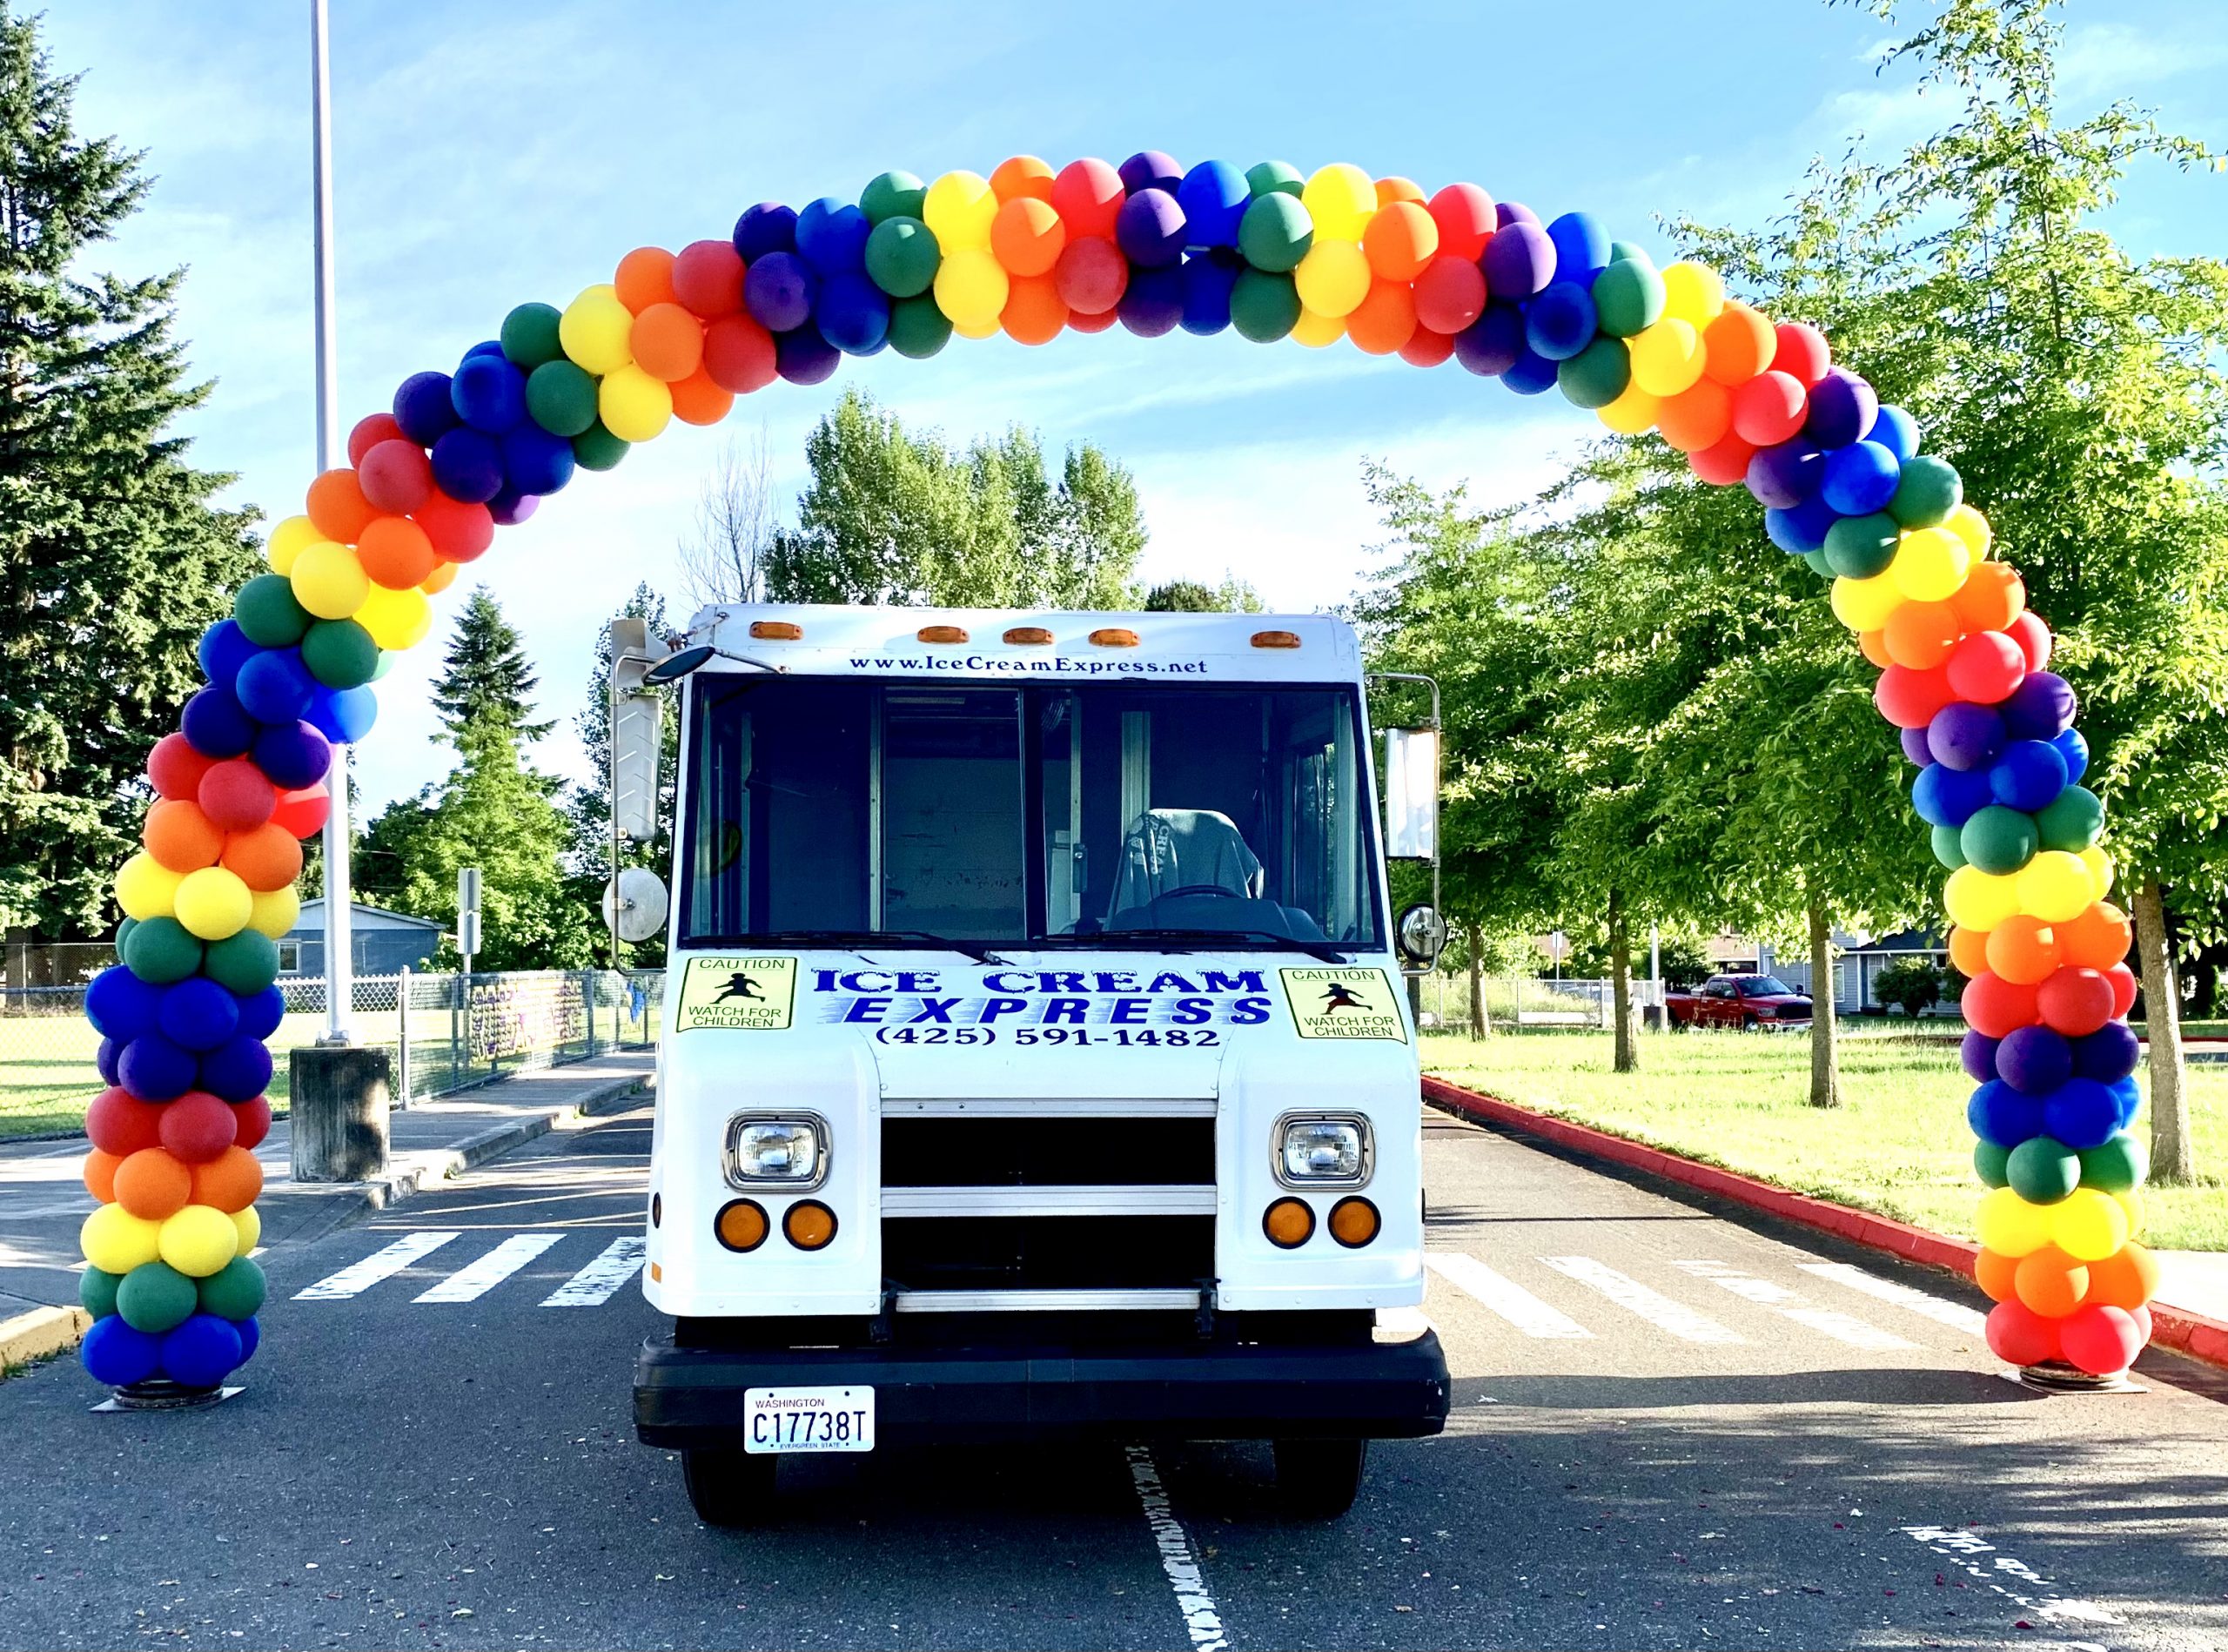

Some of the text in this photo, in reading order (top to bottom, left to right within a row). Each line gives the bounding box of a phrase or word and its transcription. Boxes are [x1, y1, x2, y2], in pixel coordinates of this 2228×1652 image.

[849, 655, 1209, 674] www.IceCreamExpress.net
[699, 959, 785, 970] CAUTION
[811, 967, 1269, 993] ICE CREAM
[1292, 970, 1375, 981] CAUTION
[688, 1006, 782, 1018] WATCH FOR
[842, 997, 1272, 1024] EXPRESS
[693, 1016, 775, 1027] CHILDREN
[1304, 1016, 1395, 1027] WATCH FOR
[876, 1027, 1220, 1047] (425) 591-1482
[1314, 1026, 1393, 1037] CHILDREN
[755, 1399, 825, 1408] WASHINGTON
[754, 1411, 866, 1443] C17738T
